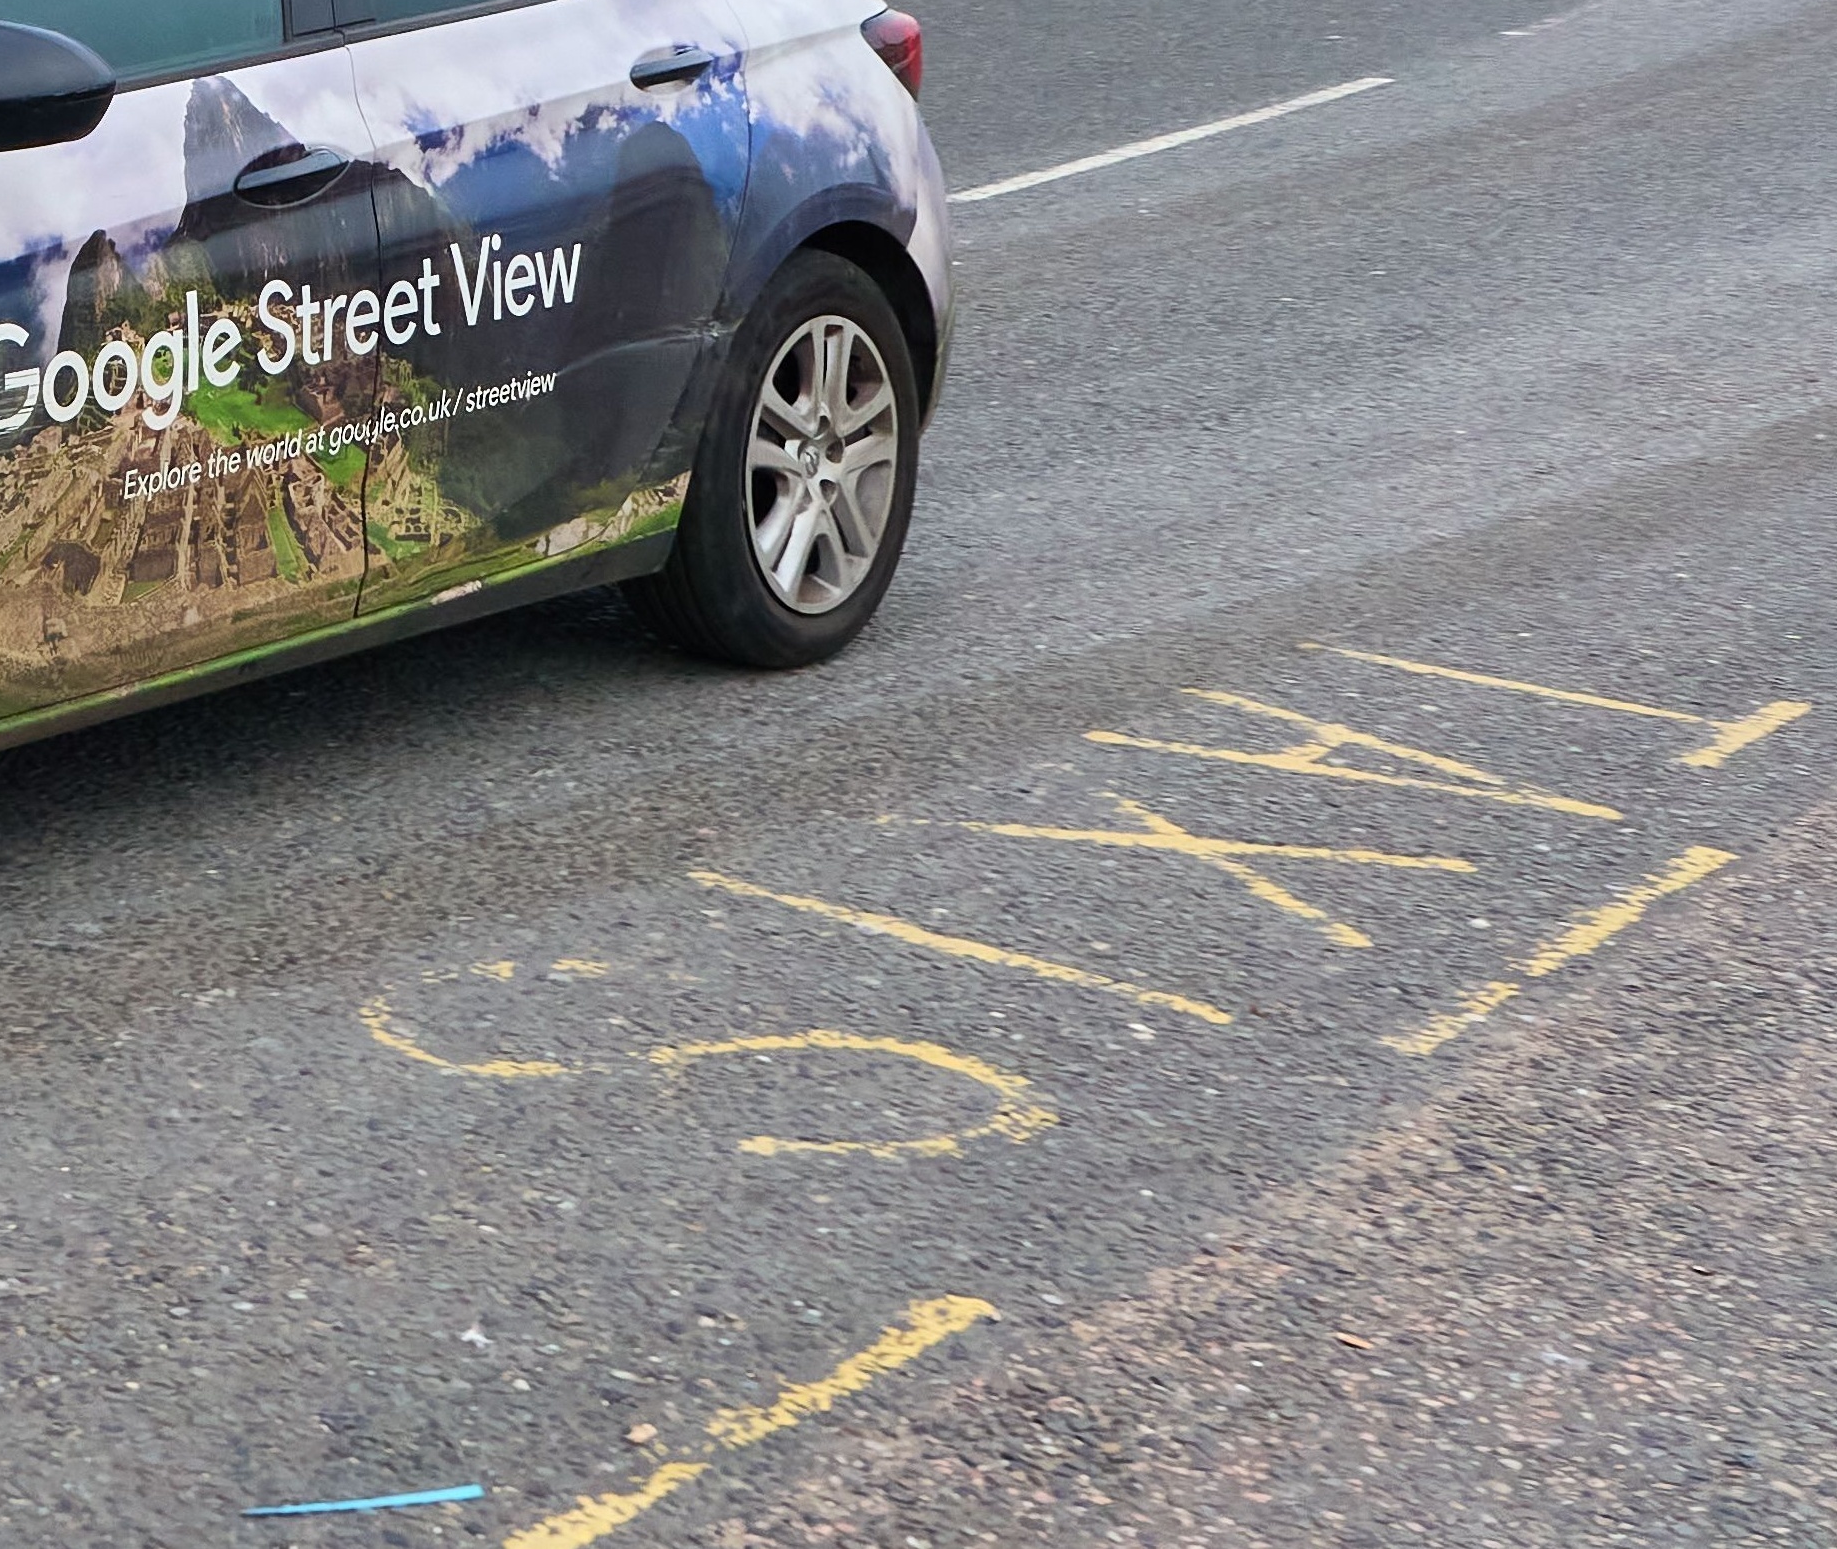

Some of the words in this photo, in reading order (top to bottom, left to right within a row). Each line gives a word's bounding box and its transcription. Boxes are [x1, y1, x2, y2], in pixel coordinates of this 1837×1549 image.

[257, 256, 441, 377] Street
[450, 233, 582, 327] View
[123, 460, 202, 502] Explore
[207, 447, 241, 480] the
[245, 428, 303, 470] world
[305, 425, 325, 454] at
